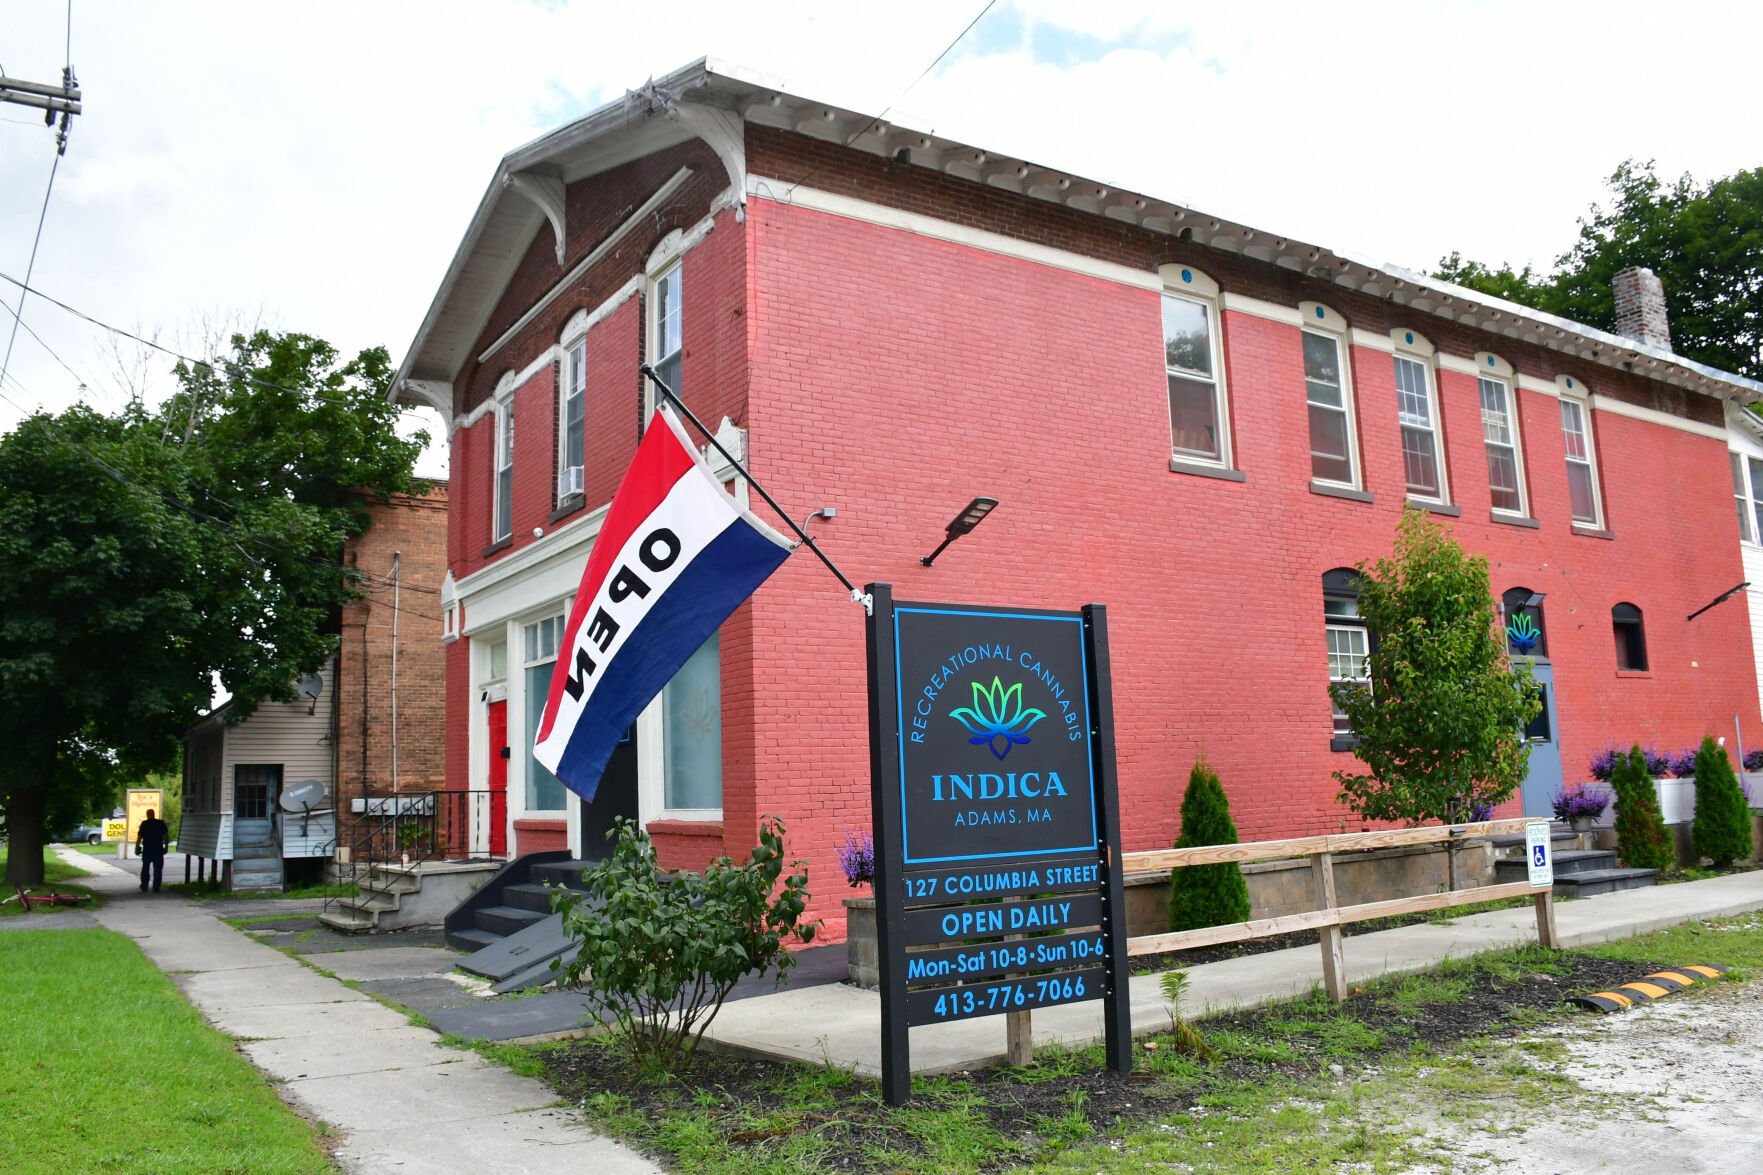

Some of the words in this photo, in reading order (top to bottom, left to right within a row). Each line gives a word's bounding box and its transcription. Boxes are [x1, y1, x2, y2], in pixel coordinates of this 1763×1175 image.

[911, 643, 1013, 743] RECREATIONAL
[1020, 652, 1082, 741] CANNABIS
[931, 772, 1068, 801] INDICA
[955, 809, 1022, 827] ADAMS,
[1027, 808, 1052, 823] MA
[906, 878, 938, 898] 127
[944, 870, 1040, 895] COLUMBIA
[1046, 864, 1098, 886] STREET
[942, 909, 1003, 936] OPEN
[1010, 903, 1071, 929] DAILY
[908, 951, 985, 979] Mon-Sat
[1070, 937, 1104, 958] 10-6
[934, 975, 1086, 1017] 413-776-7066
